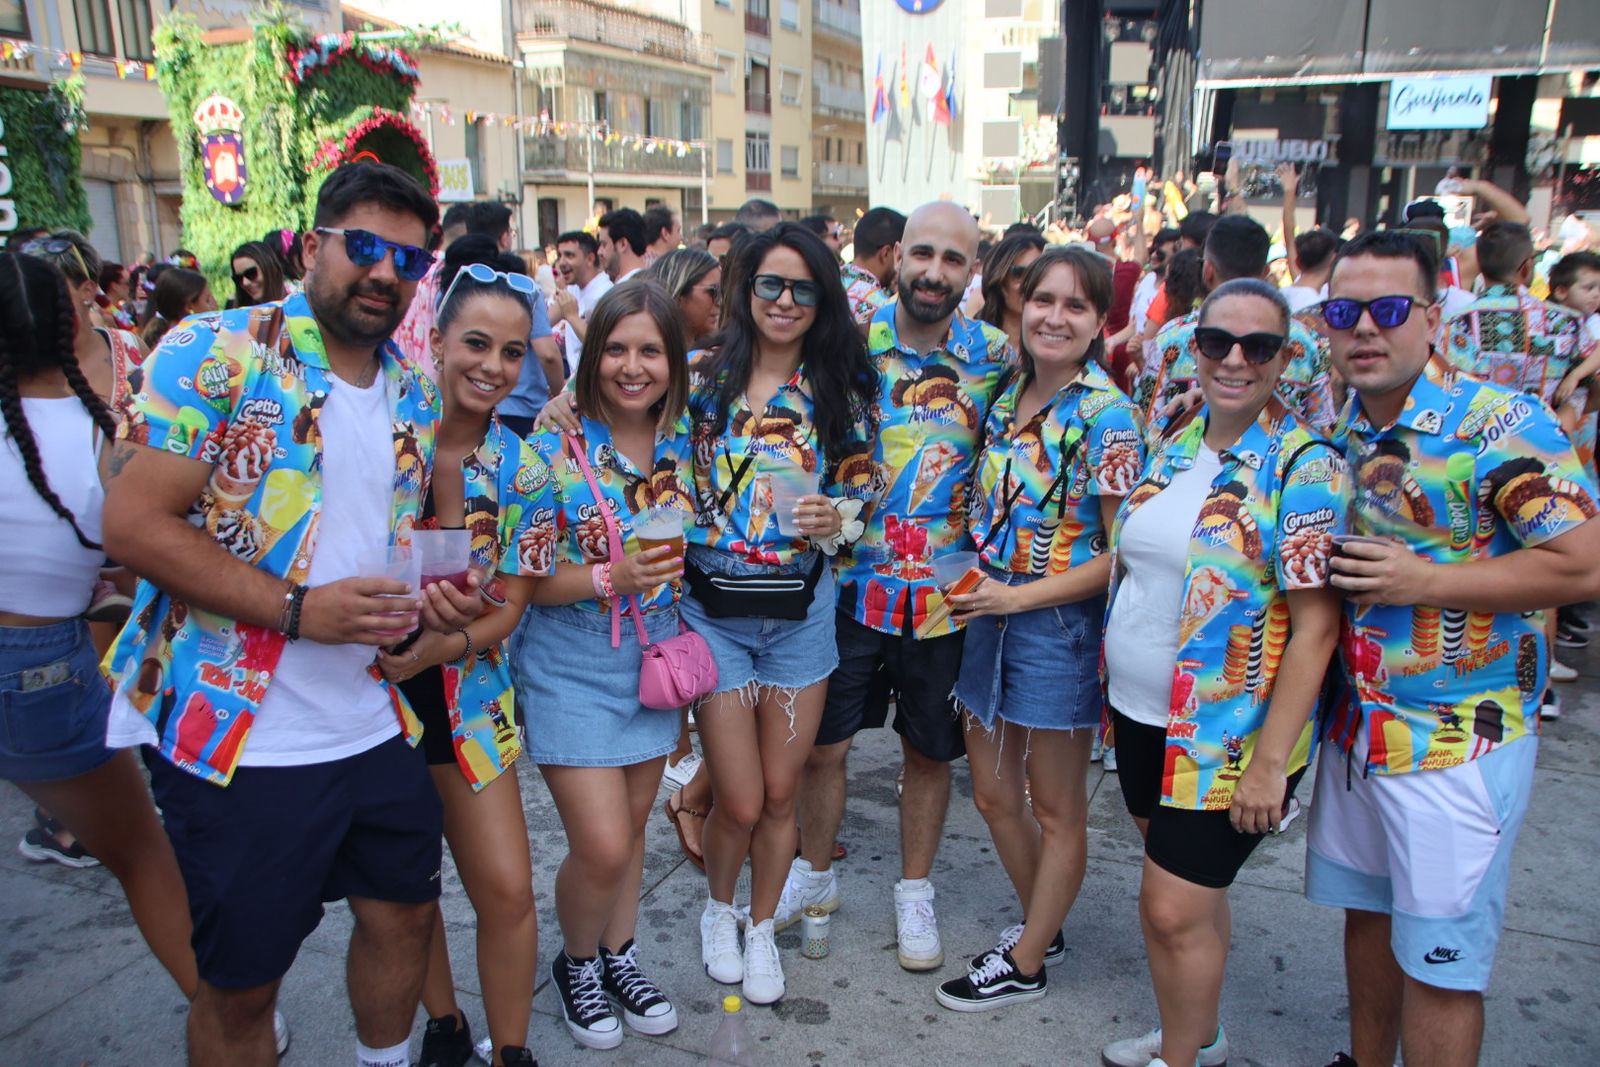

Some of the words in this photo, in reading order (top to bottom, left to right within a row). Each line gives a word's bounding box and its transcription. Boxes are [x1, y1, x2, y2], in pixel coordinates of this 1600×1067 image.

[1283, 507, 1333, 533] Cornetto
[1451, 501, 1469, 544] CALIPPO
[198, 662, 231, 690] TOM
[178, 757, 201, 775] Frigo
[1431, 946, 1461, 959] NIKE
